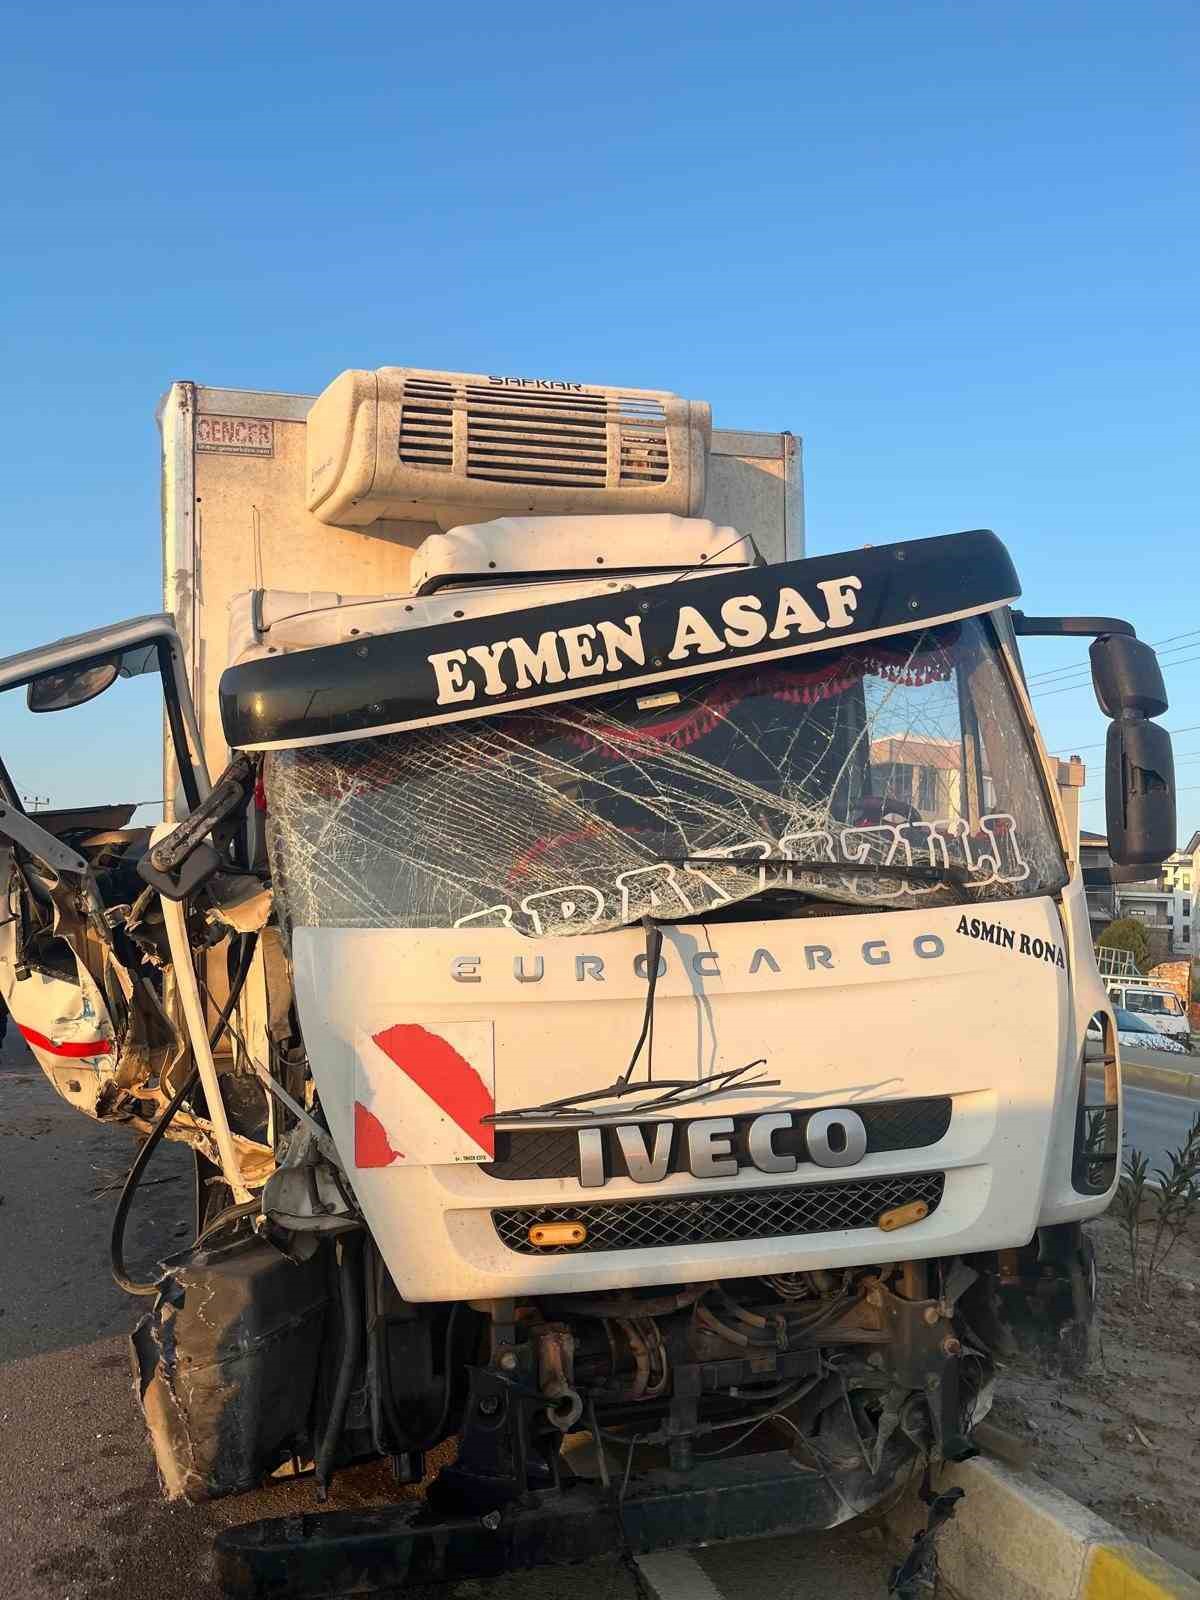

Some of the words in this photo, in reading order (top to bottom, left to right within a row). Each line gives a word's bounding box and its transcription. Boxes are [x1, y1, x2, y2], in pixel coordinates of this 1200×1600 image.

[488, 375, 583, 392] SAFKAR
[428, 615, 646, 705] EYMEN
[668, 575, 863, 660] ASAF
[450, 934, 945, 983] EUROCARGO
[956, 914, 1016, 950] ASMİN
[1019, 933, 1065, 969] RONA
[578, 1108, 868, 1187] IVECO
